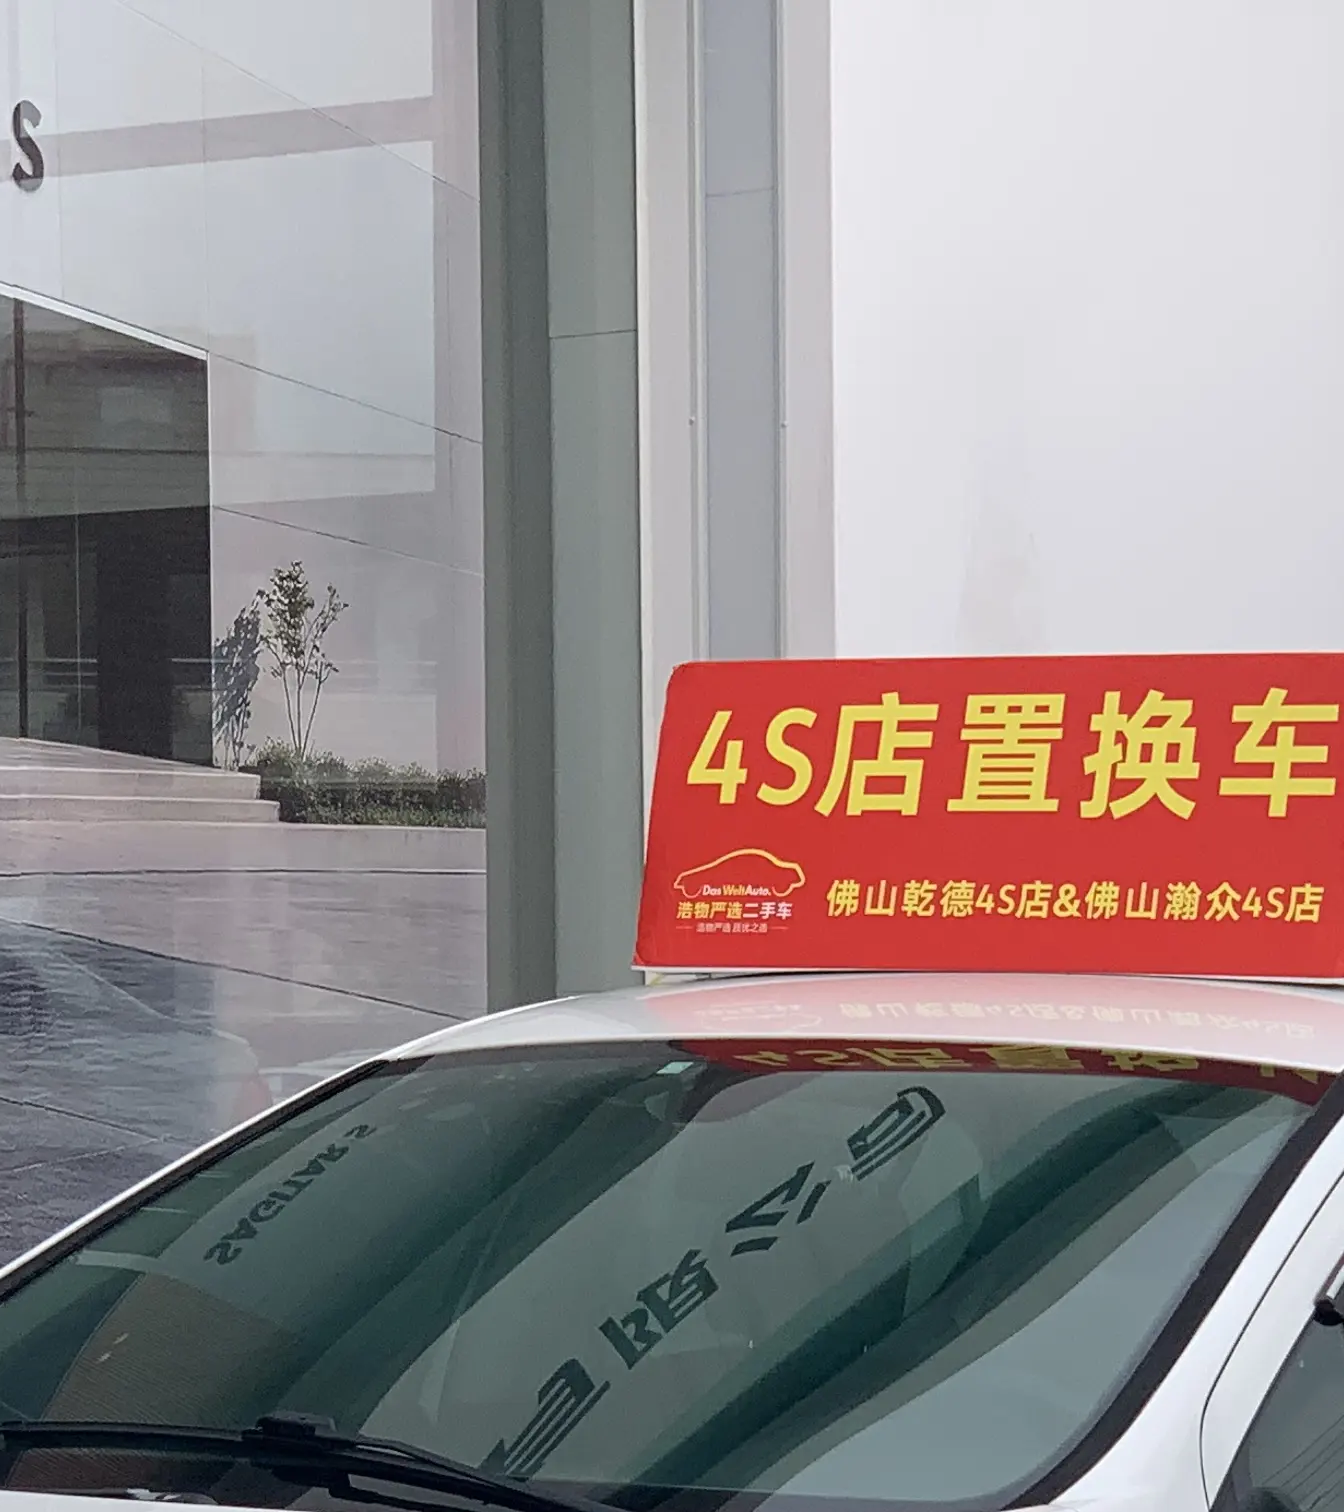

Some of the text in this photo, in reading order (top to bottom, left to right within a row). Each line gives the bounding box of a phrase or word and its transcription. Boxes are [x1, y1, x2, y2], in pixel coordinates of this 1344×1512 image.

[12, 100, 45, 192] S
[687, 687, 1340, 820] 4S店置换车
[676, 901, 793, 920] 浩物严选二手车
[702, 884, 722, 896] Das
[826, 879, 1325, 923] 佛山乾德4S店&佛山瀚众4S店
